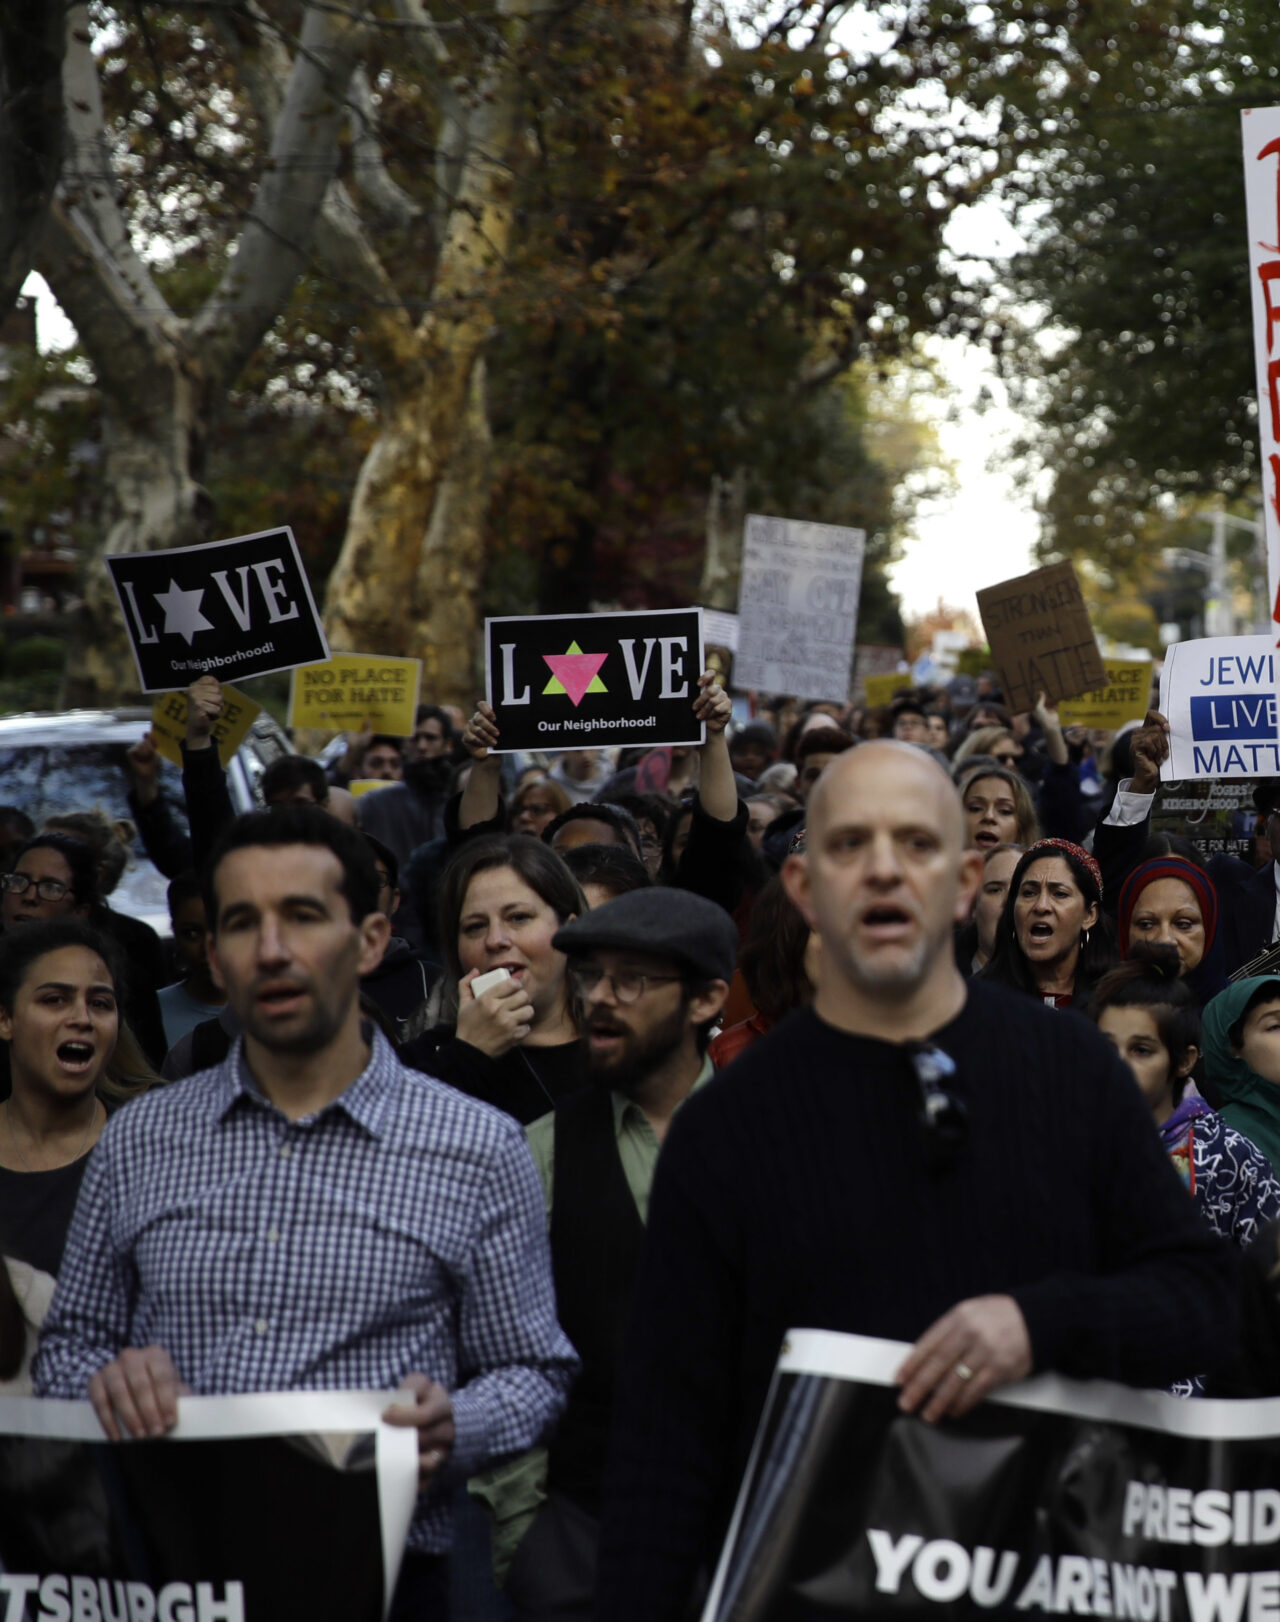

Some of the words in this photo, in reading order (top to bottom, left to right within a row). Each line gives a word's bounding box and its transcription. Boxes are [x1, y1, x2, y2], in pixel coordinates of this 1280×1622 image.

[984, 575, 1081, 629] STRONGER
[1019, 623, 1063, 644] THAN
[170, 658, 187, 672] Our
[188, 641, 275, 672] Neighborhood!
[303, 669, 336, 686] NO
[340, 667, 407, 685] PLACE
[1001, 639, 1105, 711] HATE
[1108, 668, 1143, 684] ACE
[1200, 654, 1275, 687] JEWI
[304, 688, 345, 705] FOR
[350, 687, 406, 704] HATE
[1091, 687, 1141, 703] HATE
[537, 720, 561, 732] Our
[563, 715, 657, 733] Neighborhood!
[1211, 699, 1278, 729] LIVE
[1162, 798, 1239, 810] NEIGHBORHOOD
[1208, 839, 1224, 851] FOR
[1226, 839, 1250, 852] HATE
[867, 1528, 1018, 1610] YOU
[1016, 1554, 1112, 1618] ARE
[1110, 1561, 1176, 1622] NOT
